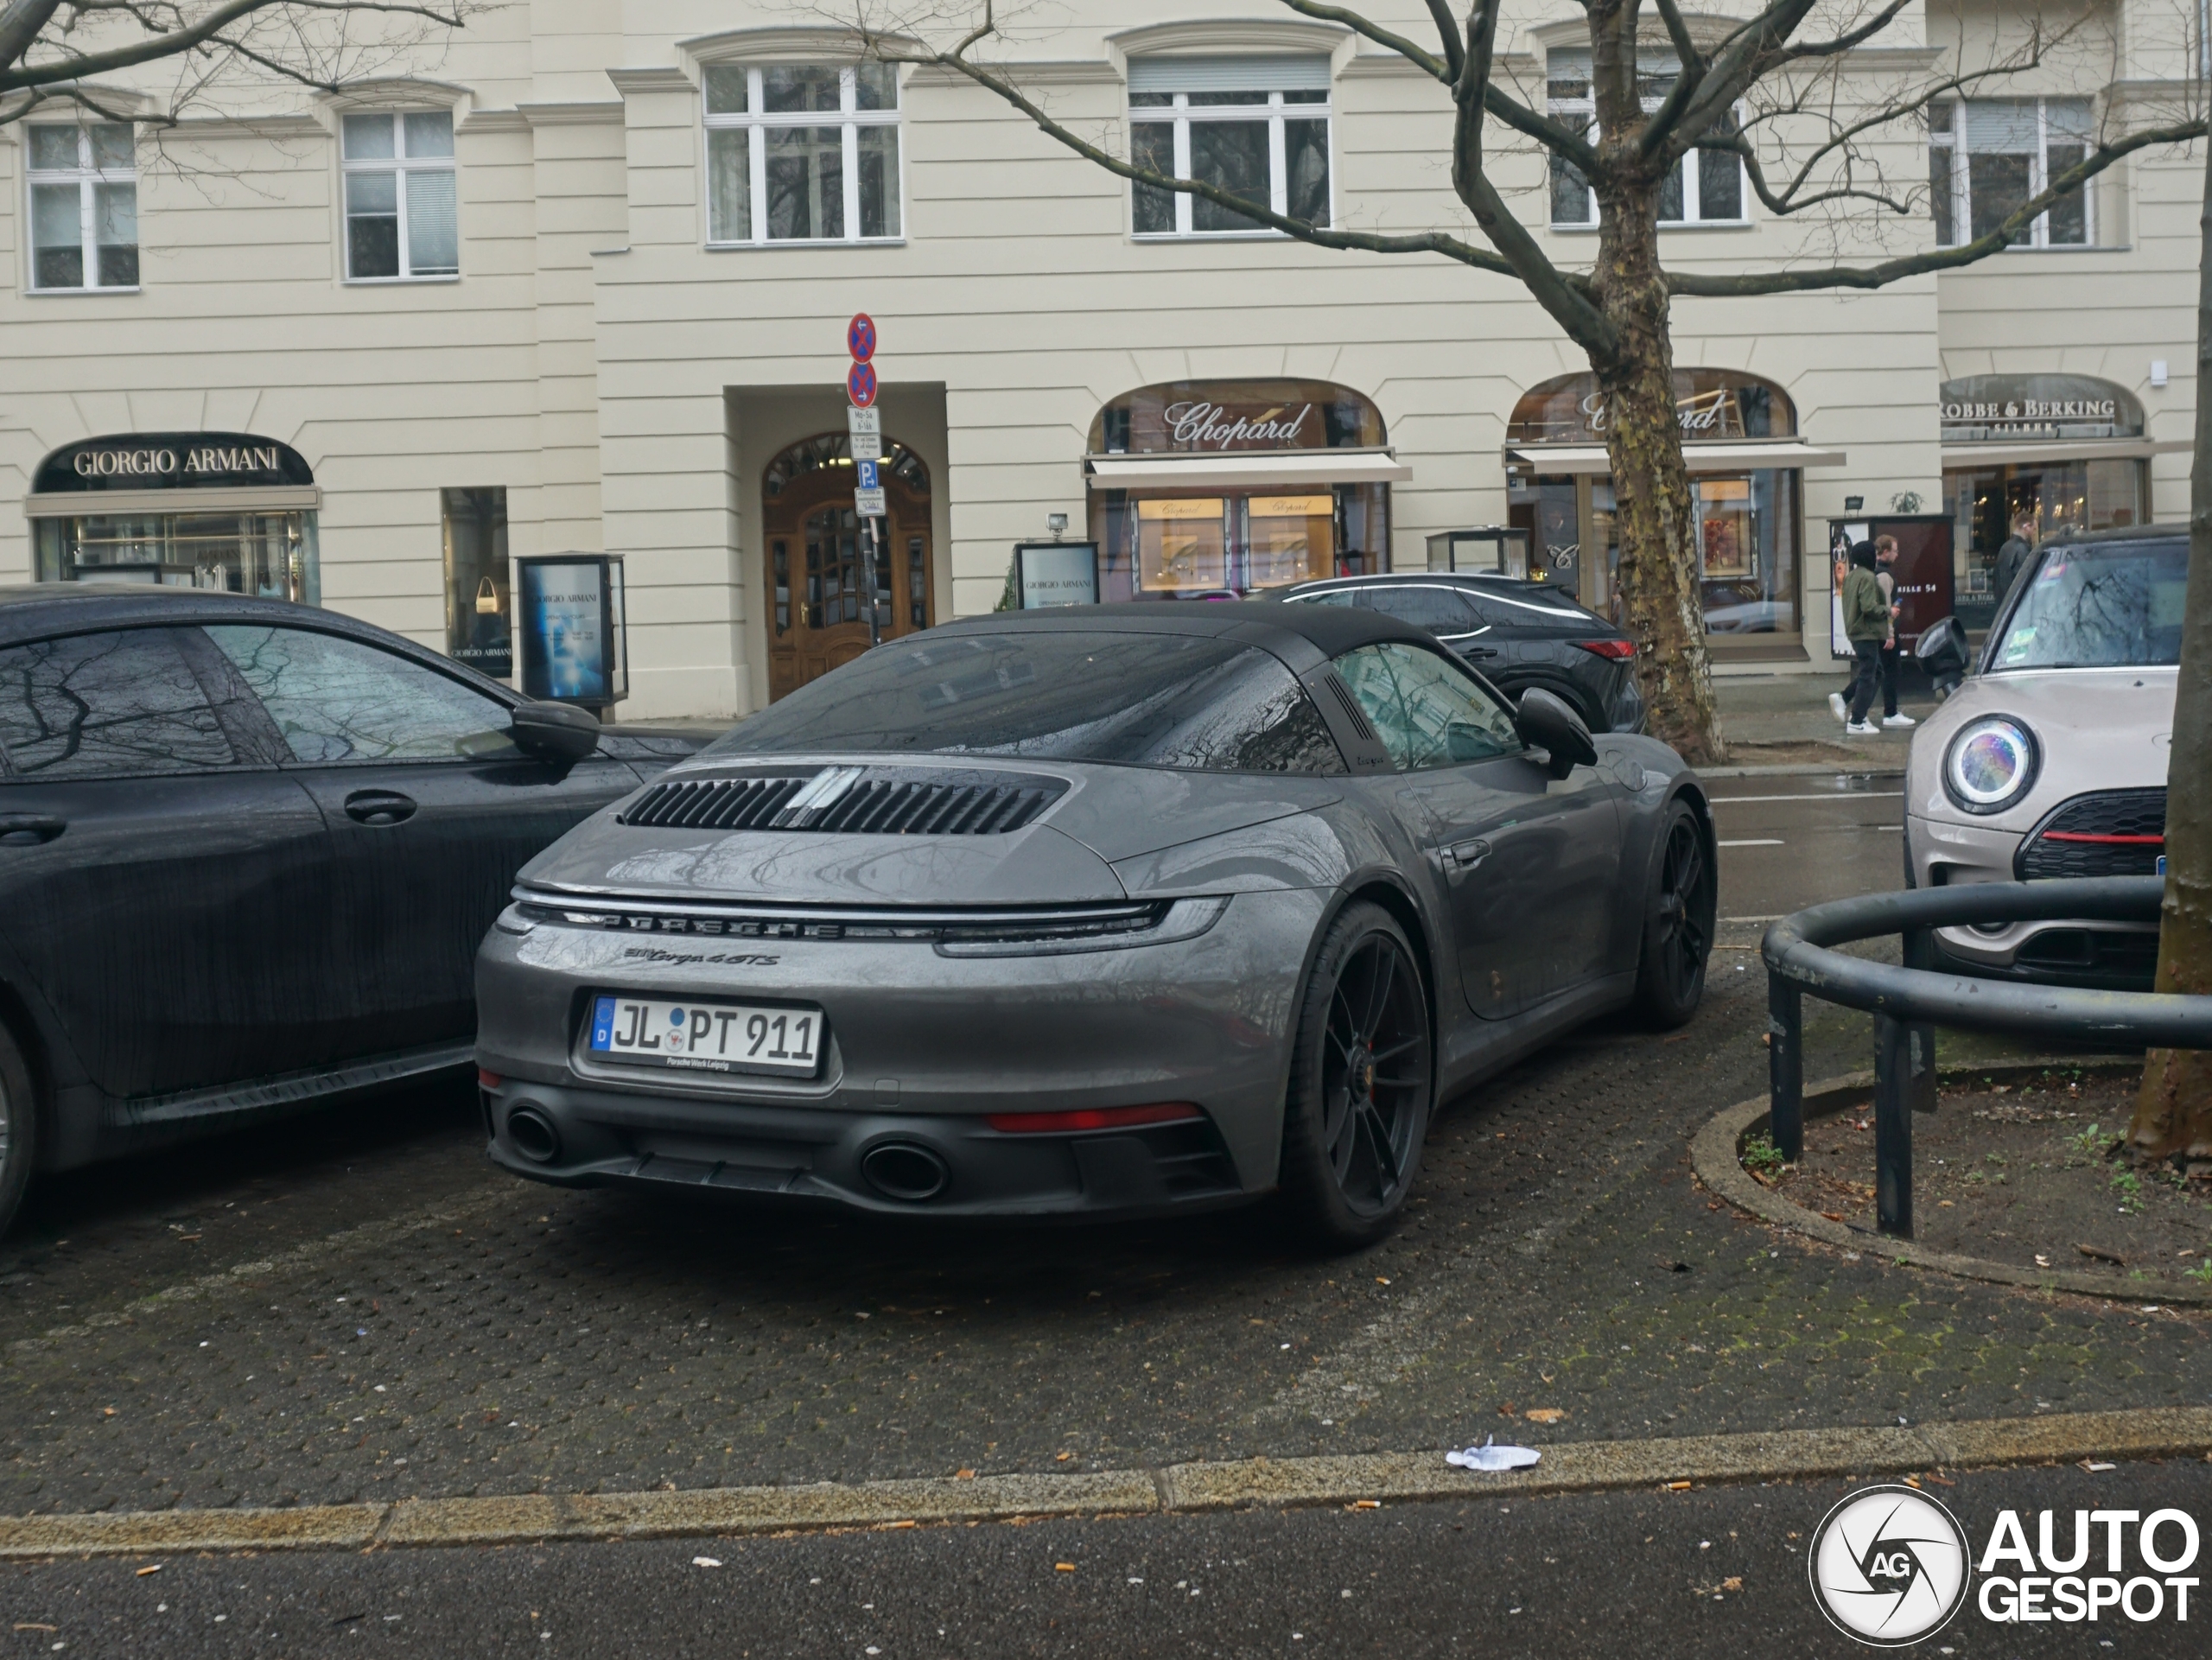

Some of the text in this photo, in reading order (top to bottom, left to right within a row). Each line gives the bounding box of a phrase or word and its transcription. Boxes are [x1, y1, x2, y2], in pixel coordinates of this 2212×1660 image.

[2005, 400, 2018, 417] &
[2024, 398, 2116, 417] BERKING
[1164, 401, 1312, 450] Chopard
[1994, 422, 2053, 433] SILBER
[73, 446, 278, 476] GIORGIO ARMANI
[861, 462, 872, 487] P
[1160, 502, 1202, 517] Chopard
[1271, 499, 1312, 512] Chopard
[1026, 579, 1090, 589] GIORGIO ARMANI
[1925, 583, 1936, 593] 54
[567, 593, 597, 603] ARMANI
[451, 646, 512, 658] GIORGIO ARMANI
[604, 913, 842, 940] PORSCHE
[647, 949, 704, 966] Targa
[705, 953, 727, 964] 4
[724, 954, 780, 966] GTS
[597, 1004, 813, 1061] D JL PT 911
[666, 1056, 729, 1072] Porsche Werk Leipzig
